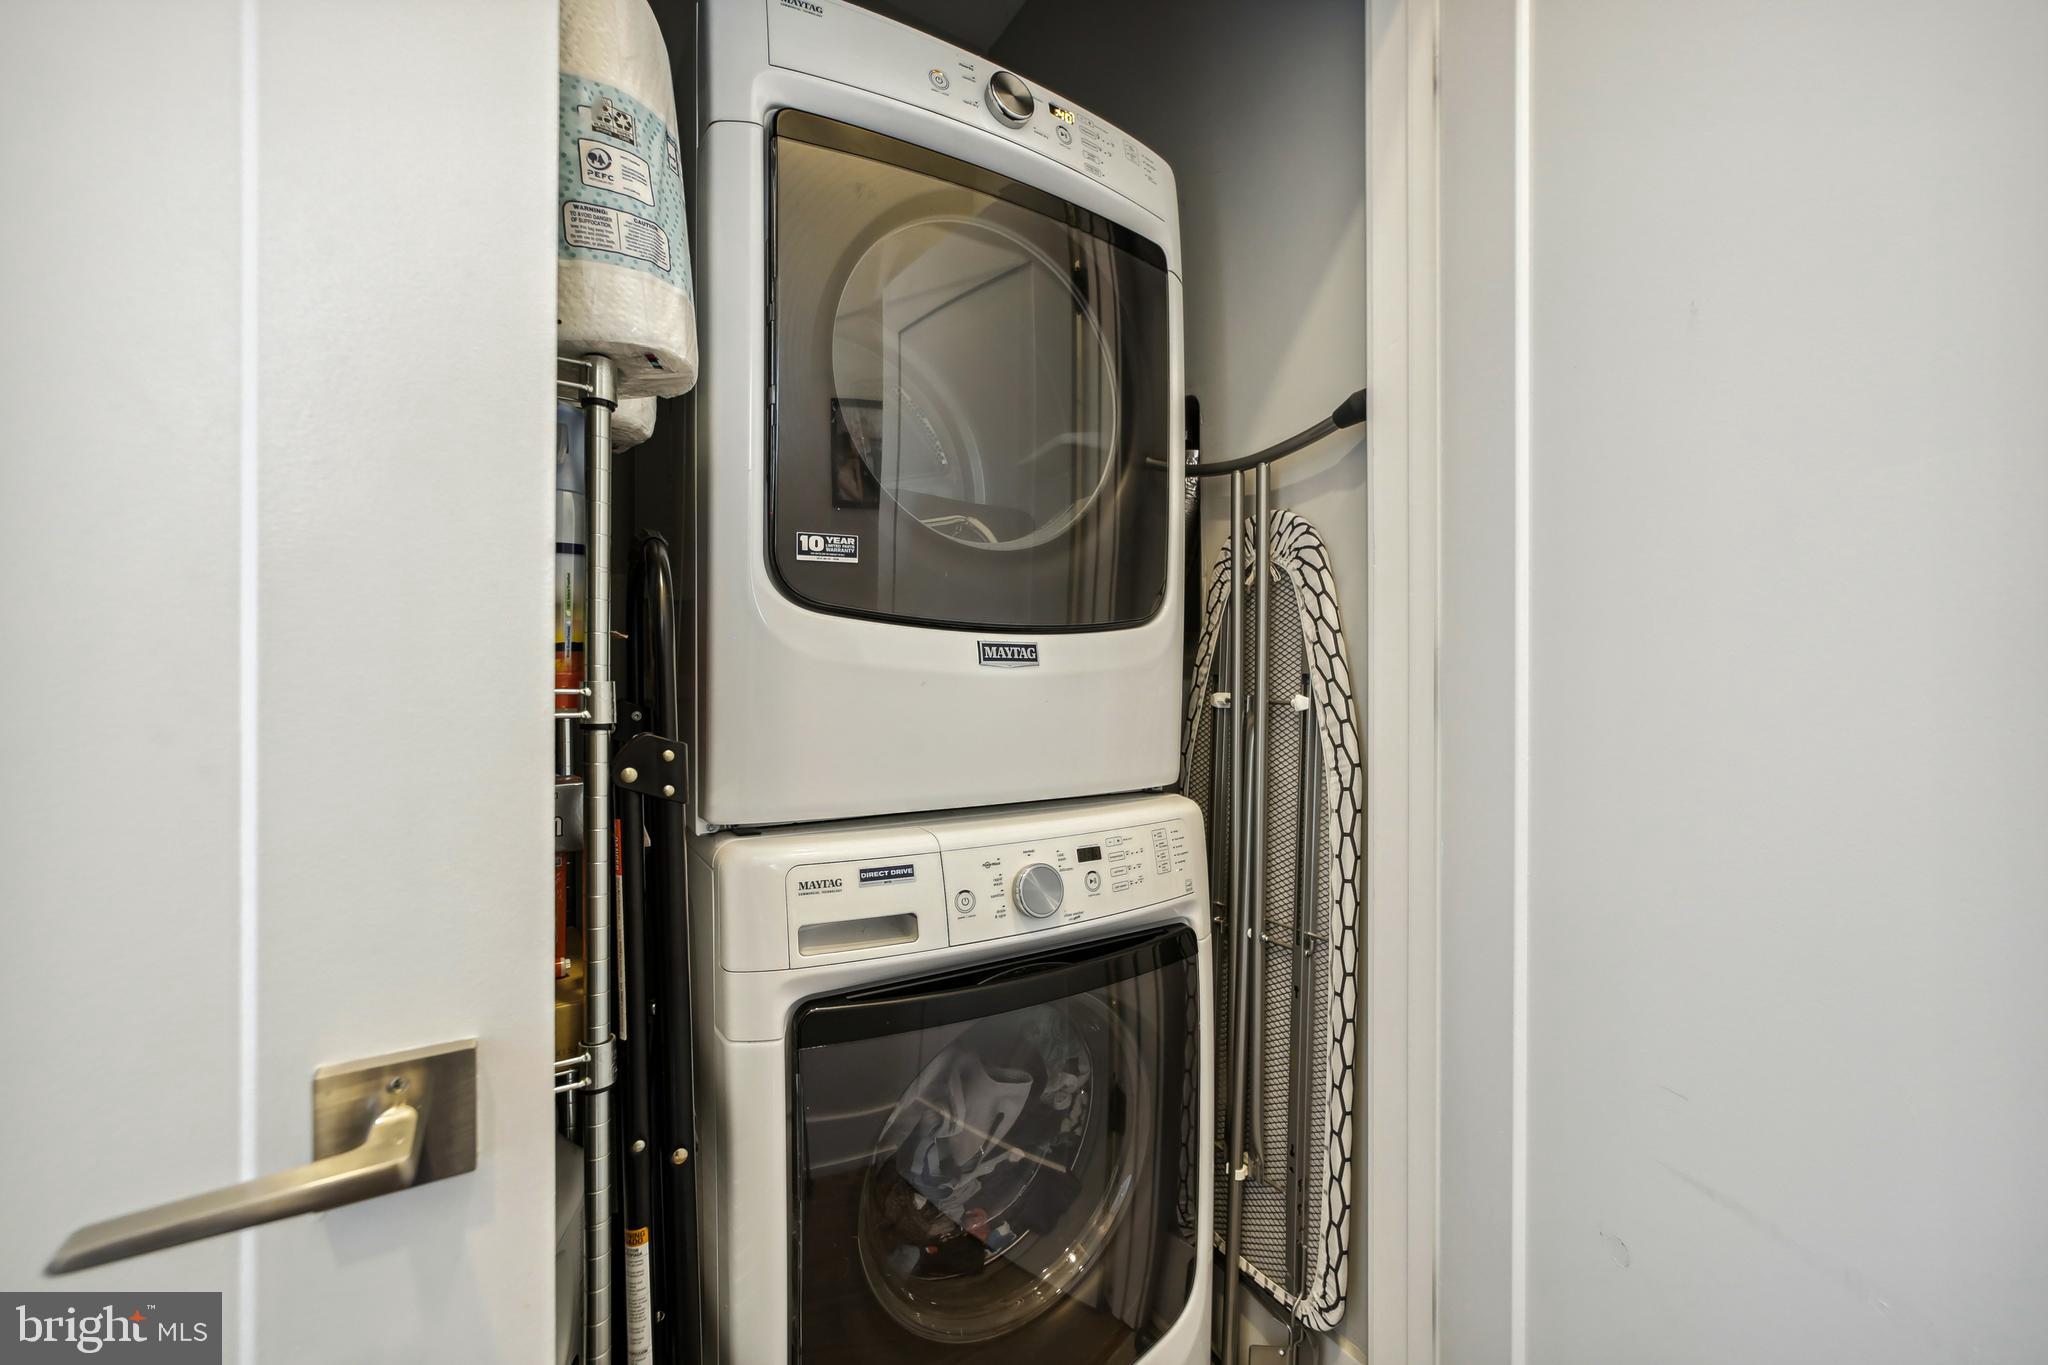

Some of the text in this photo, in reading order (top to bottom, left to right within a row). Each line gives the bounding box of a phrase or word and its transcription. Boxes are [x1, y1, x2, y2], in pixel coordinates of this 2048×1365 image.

[587, 169, 614, 181] PEFC
[577, 211, 592, 219] AVOID
[593, 214, 612, 222] DANGER
[799, 534, 824, 552] 10
[825, 536, 855, 545] YEAR
[984, 646, 1037, 659] MAYTAG
[860, 867, 913, 879] DIRECT DRIVE
[798, 878, 843, 891] MAYTAG
